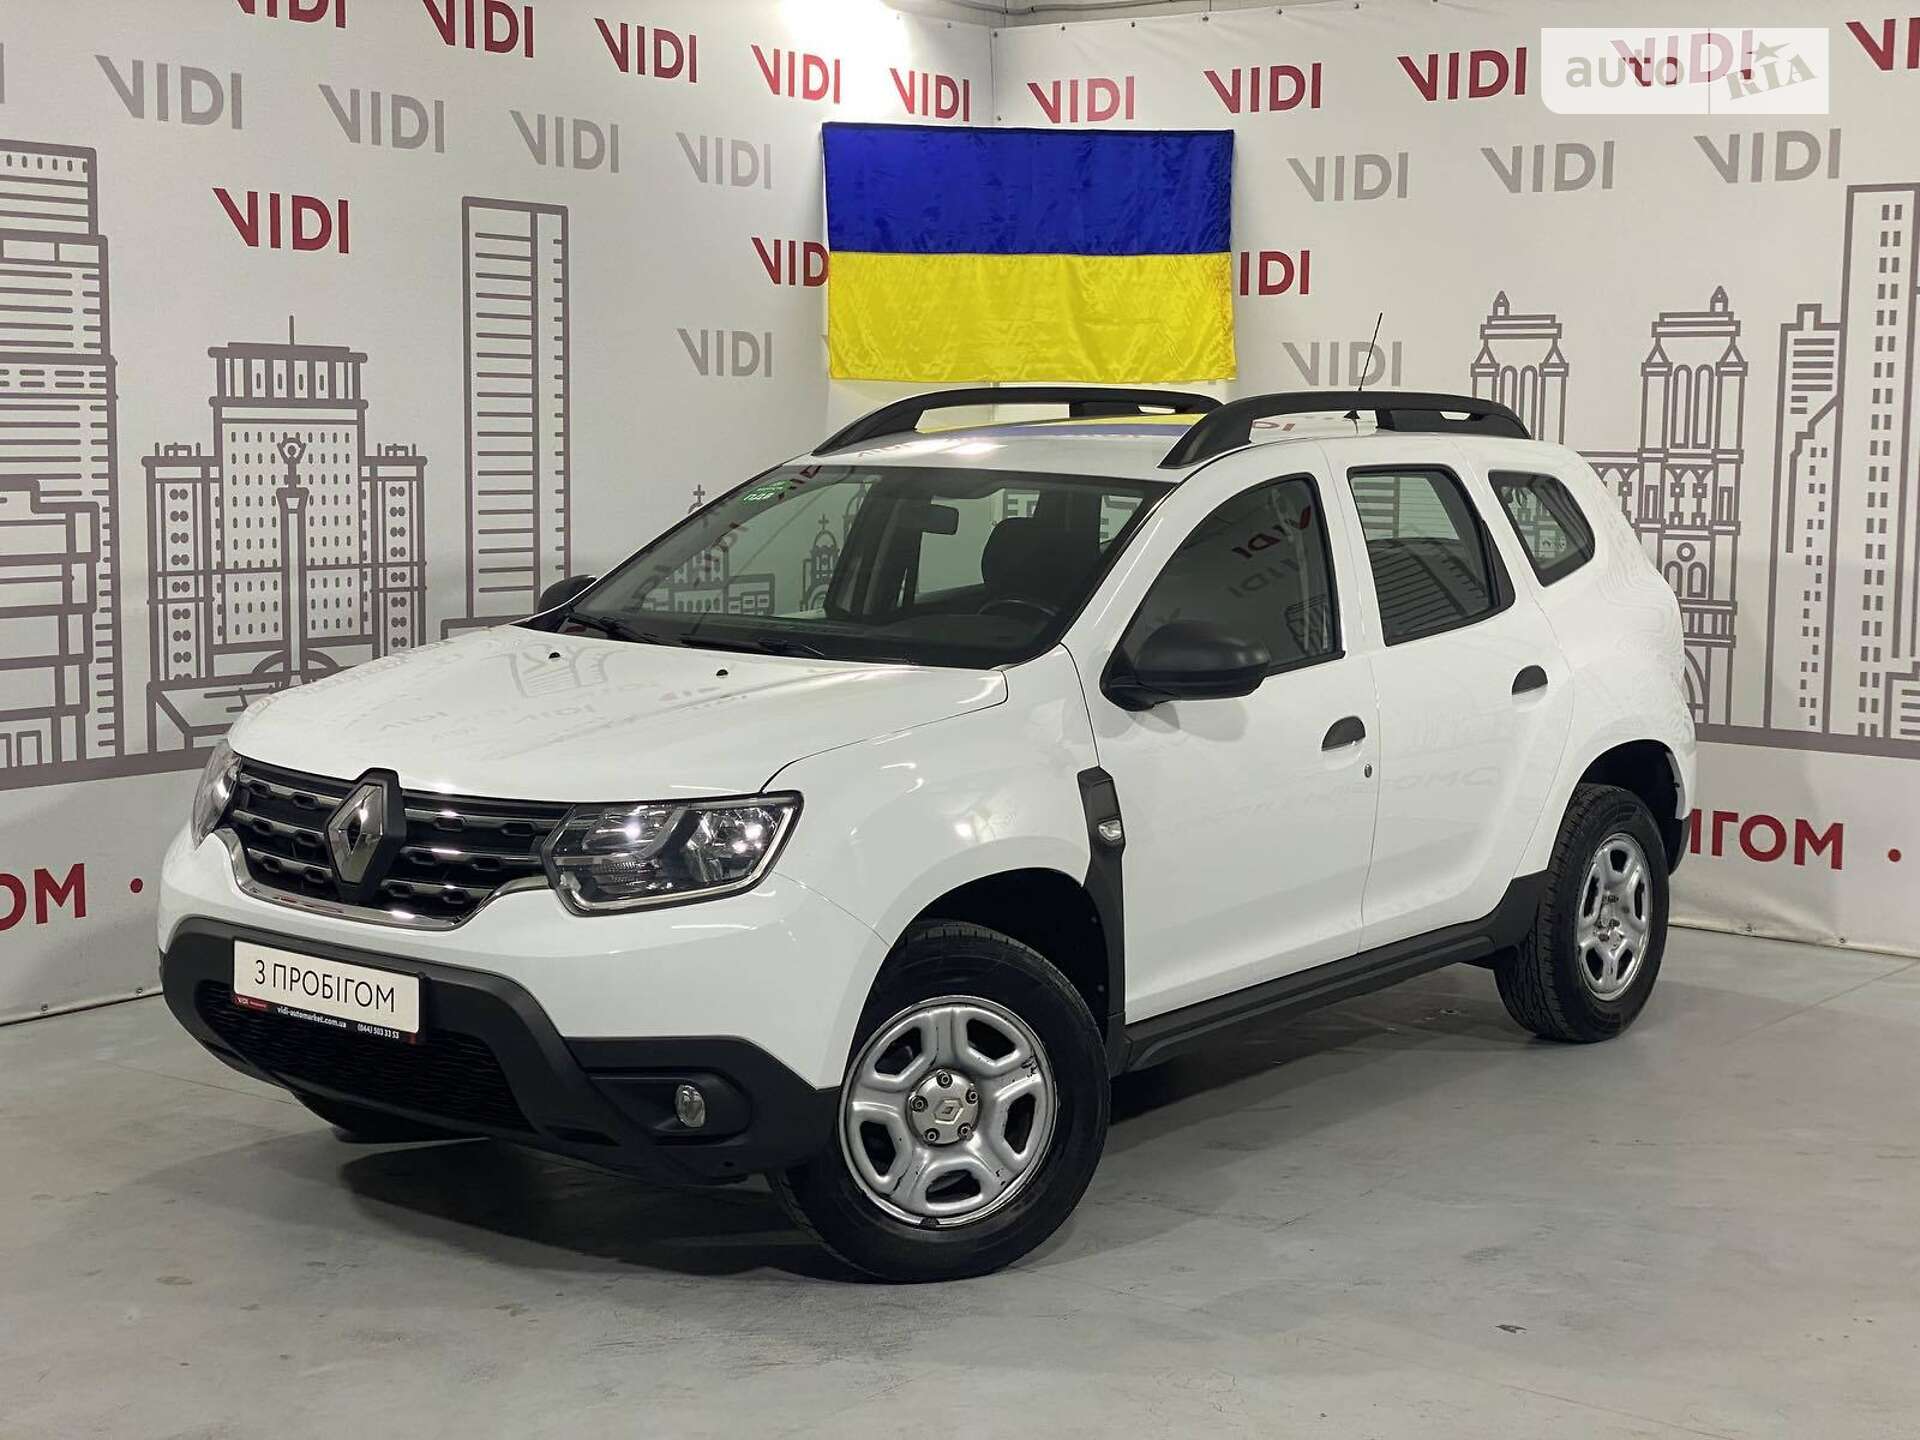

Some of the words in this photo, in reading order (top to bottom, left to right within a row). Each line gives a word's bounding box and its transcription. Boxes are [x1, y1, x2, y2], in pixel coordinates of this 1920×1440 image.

[423, 0, 534, 58] VIDI
[594, 17, 697, 83] VIDI
[95, 55, 242, 129] VIDI
[751, 44, 840, 104] VIDI
[890, 68, 970, 122] VIDI
[1027, 76, 1135, 124] VIDI
[1204, 62, 1322, 114] VIDI
[1397, 47, 1527, 102] VIDI
[318, 84, 444, 153] VIDI
[509, 110, 619, 173] VIDI
[676, 132, 771, 189] VIDI
[1287, 152, 1409, 202] VIDI
[1480, 140, 1615, 193] VIDI
[1693, 128, 1841, 184] VIDI
[212, 187, 349, 254] VIDI
[677, 328, 772, 378] VIDI
[1283, 341, 1402, 386] VIDI
[255, 959, 266, 985] З
[273, 963, 395, 1013] ПРОБІГОМ
